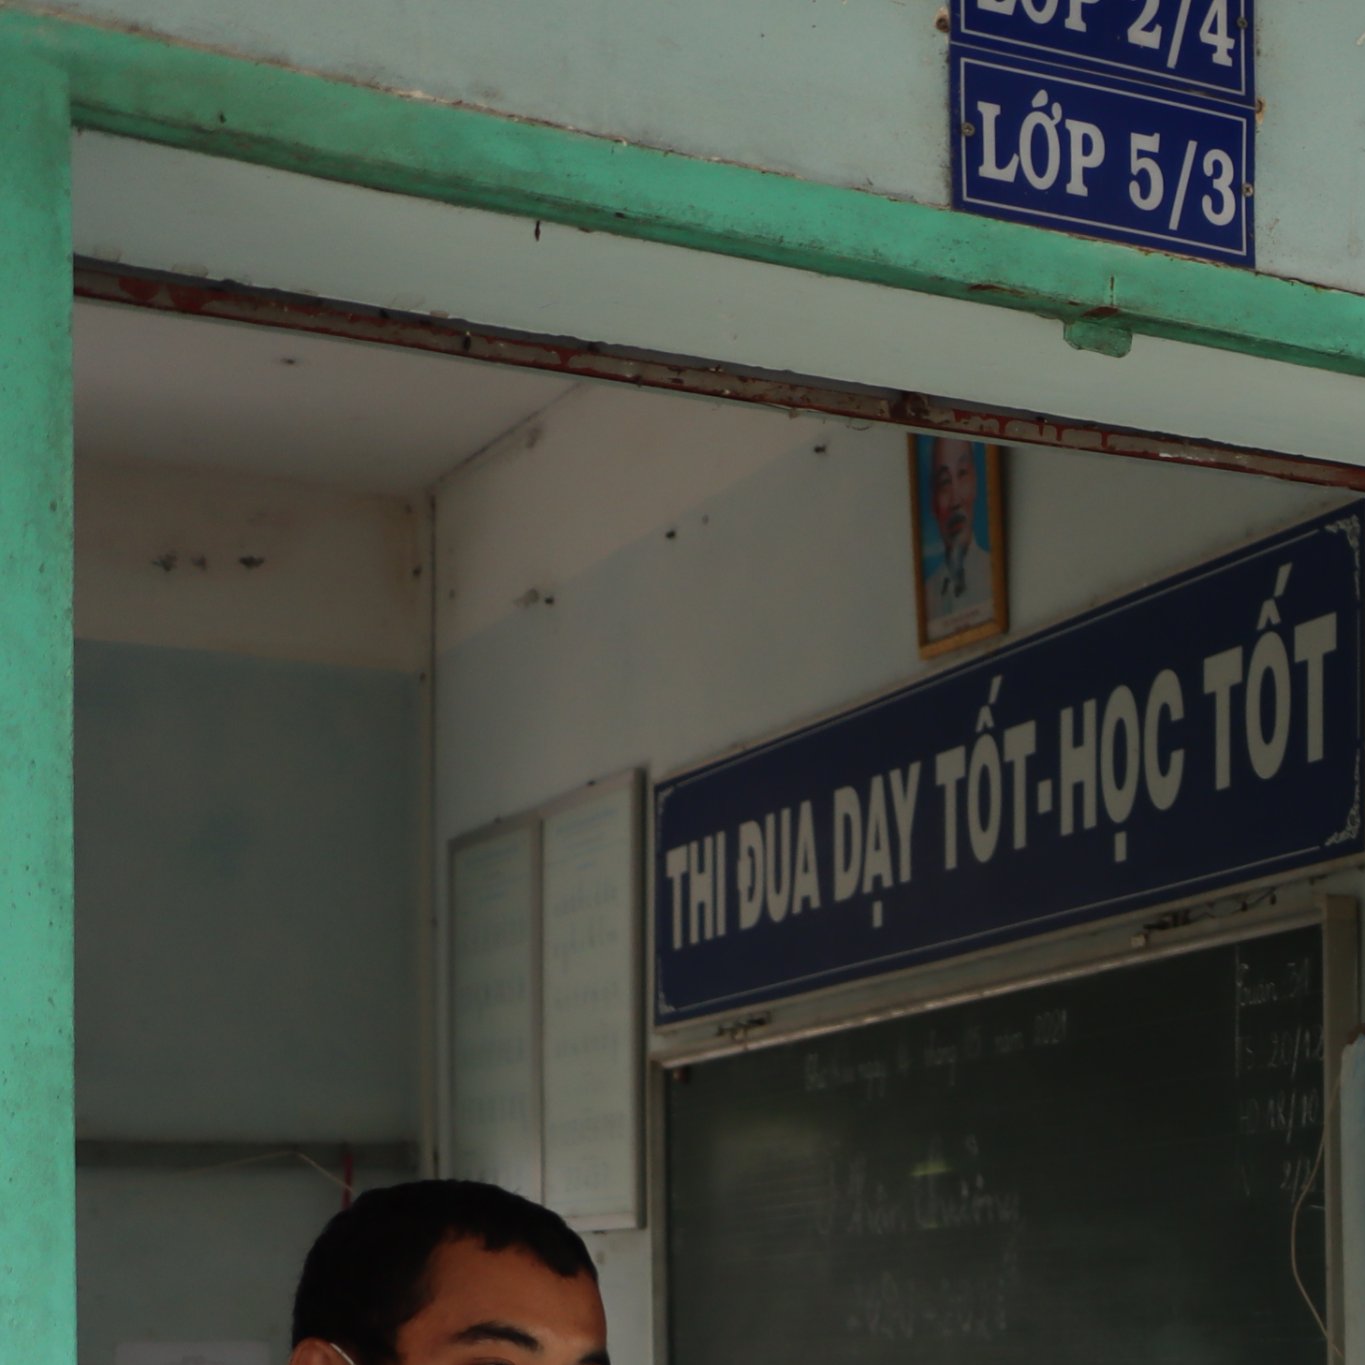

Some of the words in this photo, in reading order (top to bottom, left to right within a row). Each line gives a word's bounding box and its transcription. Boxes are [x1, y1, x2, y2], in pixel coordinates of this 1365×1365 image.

[1127, 0, 1236, 67] 2/4
[977, 89, 1106, 197] LỚP
[1129, 132, 1236, 231] 5/3
[666, 830, 727, 950] THI
[736, 801, 821, 932] ĐUA
[833, 760, 922, 929] DẠY
[1202, 562, 1338, 793] TỐT
